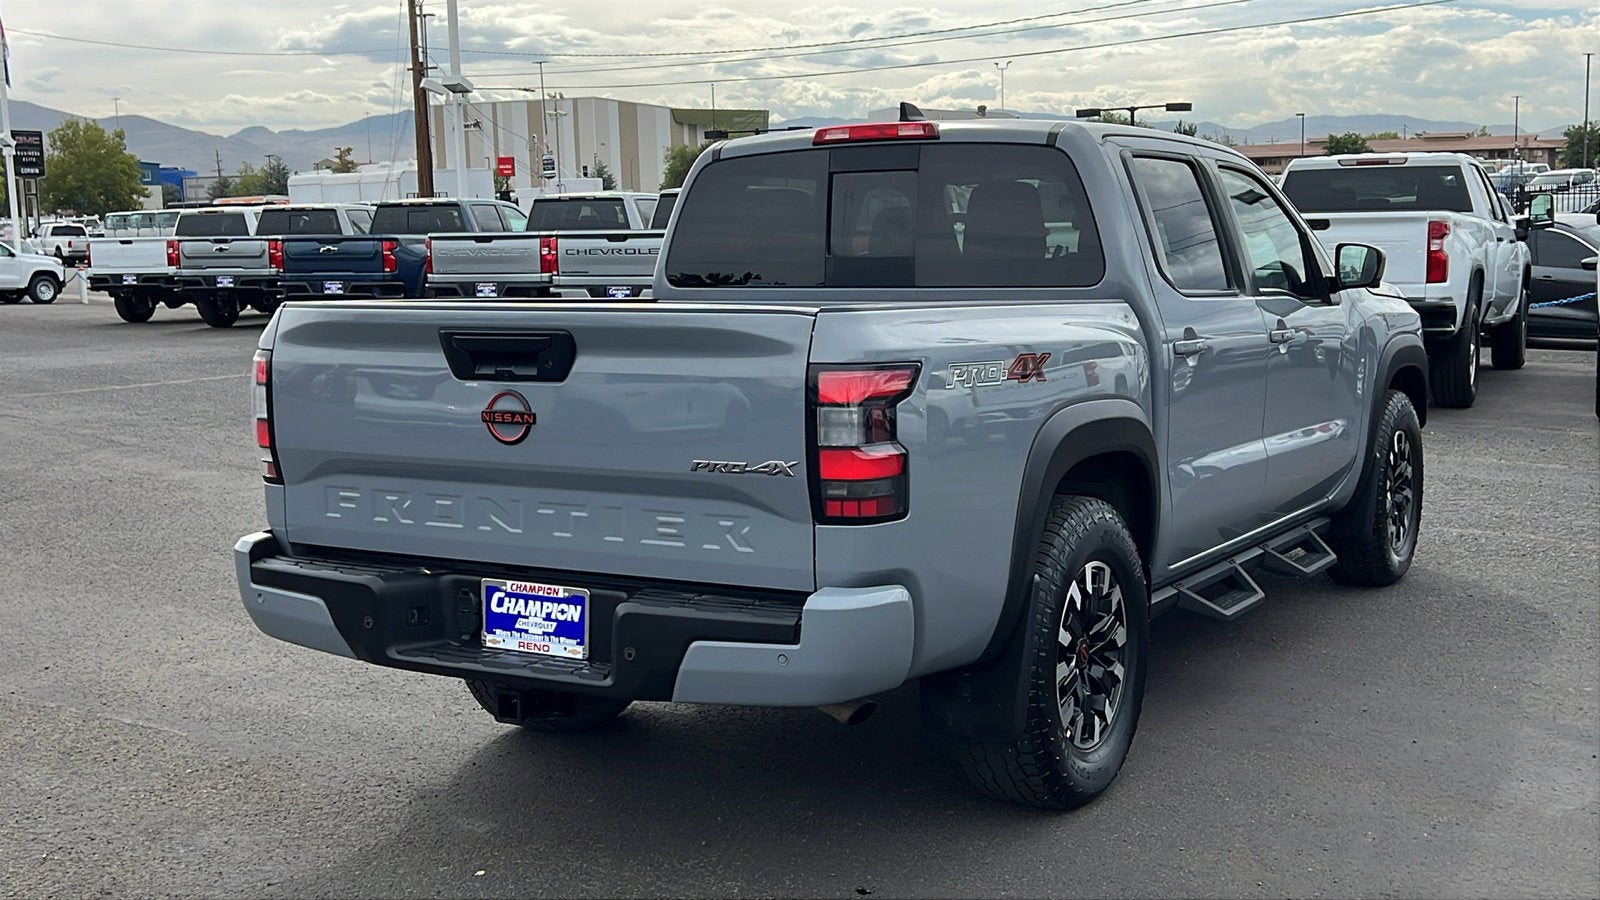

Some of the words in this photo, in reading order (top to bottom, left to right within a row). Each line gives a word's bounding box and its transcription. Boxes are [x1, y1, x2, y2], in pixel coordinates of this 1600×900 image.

[15, 136, 40, 144] GMC
[437, 247, 531, 257] CHEVROLET
[565, 248, 661, 256] CHEVROLE
[482, 411, 534, 424] NISSAN
[690, 459, 800, 478] PRO-4X
[324, 485, 755, 553] FRONTIER
[510, 583, 560, 596] CHAMPION
[490, 592, 582, 622] CHAMPION
[518, 620, 553, 630] CHEVROLET
[518, 641, 550, 653] RENO
